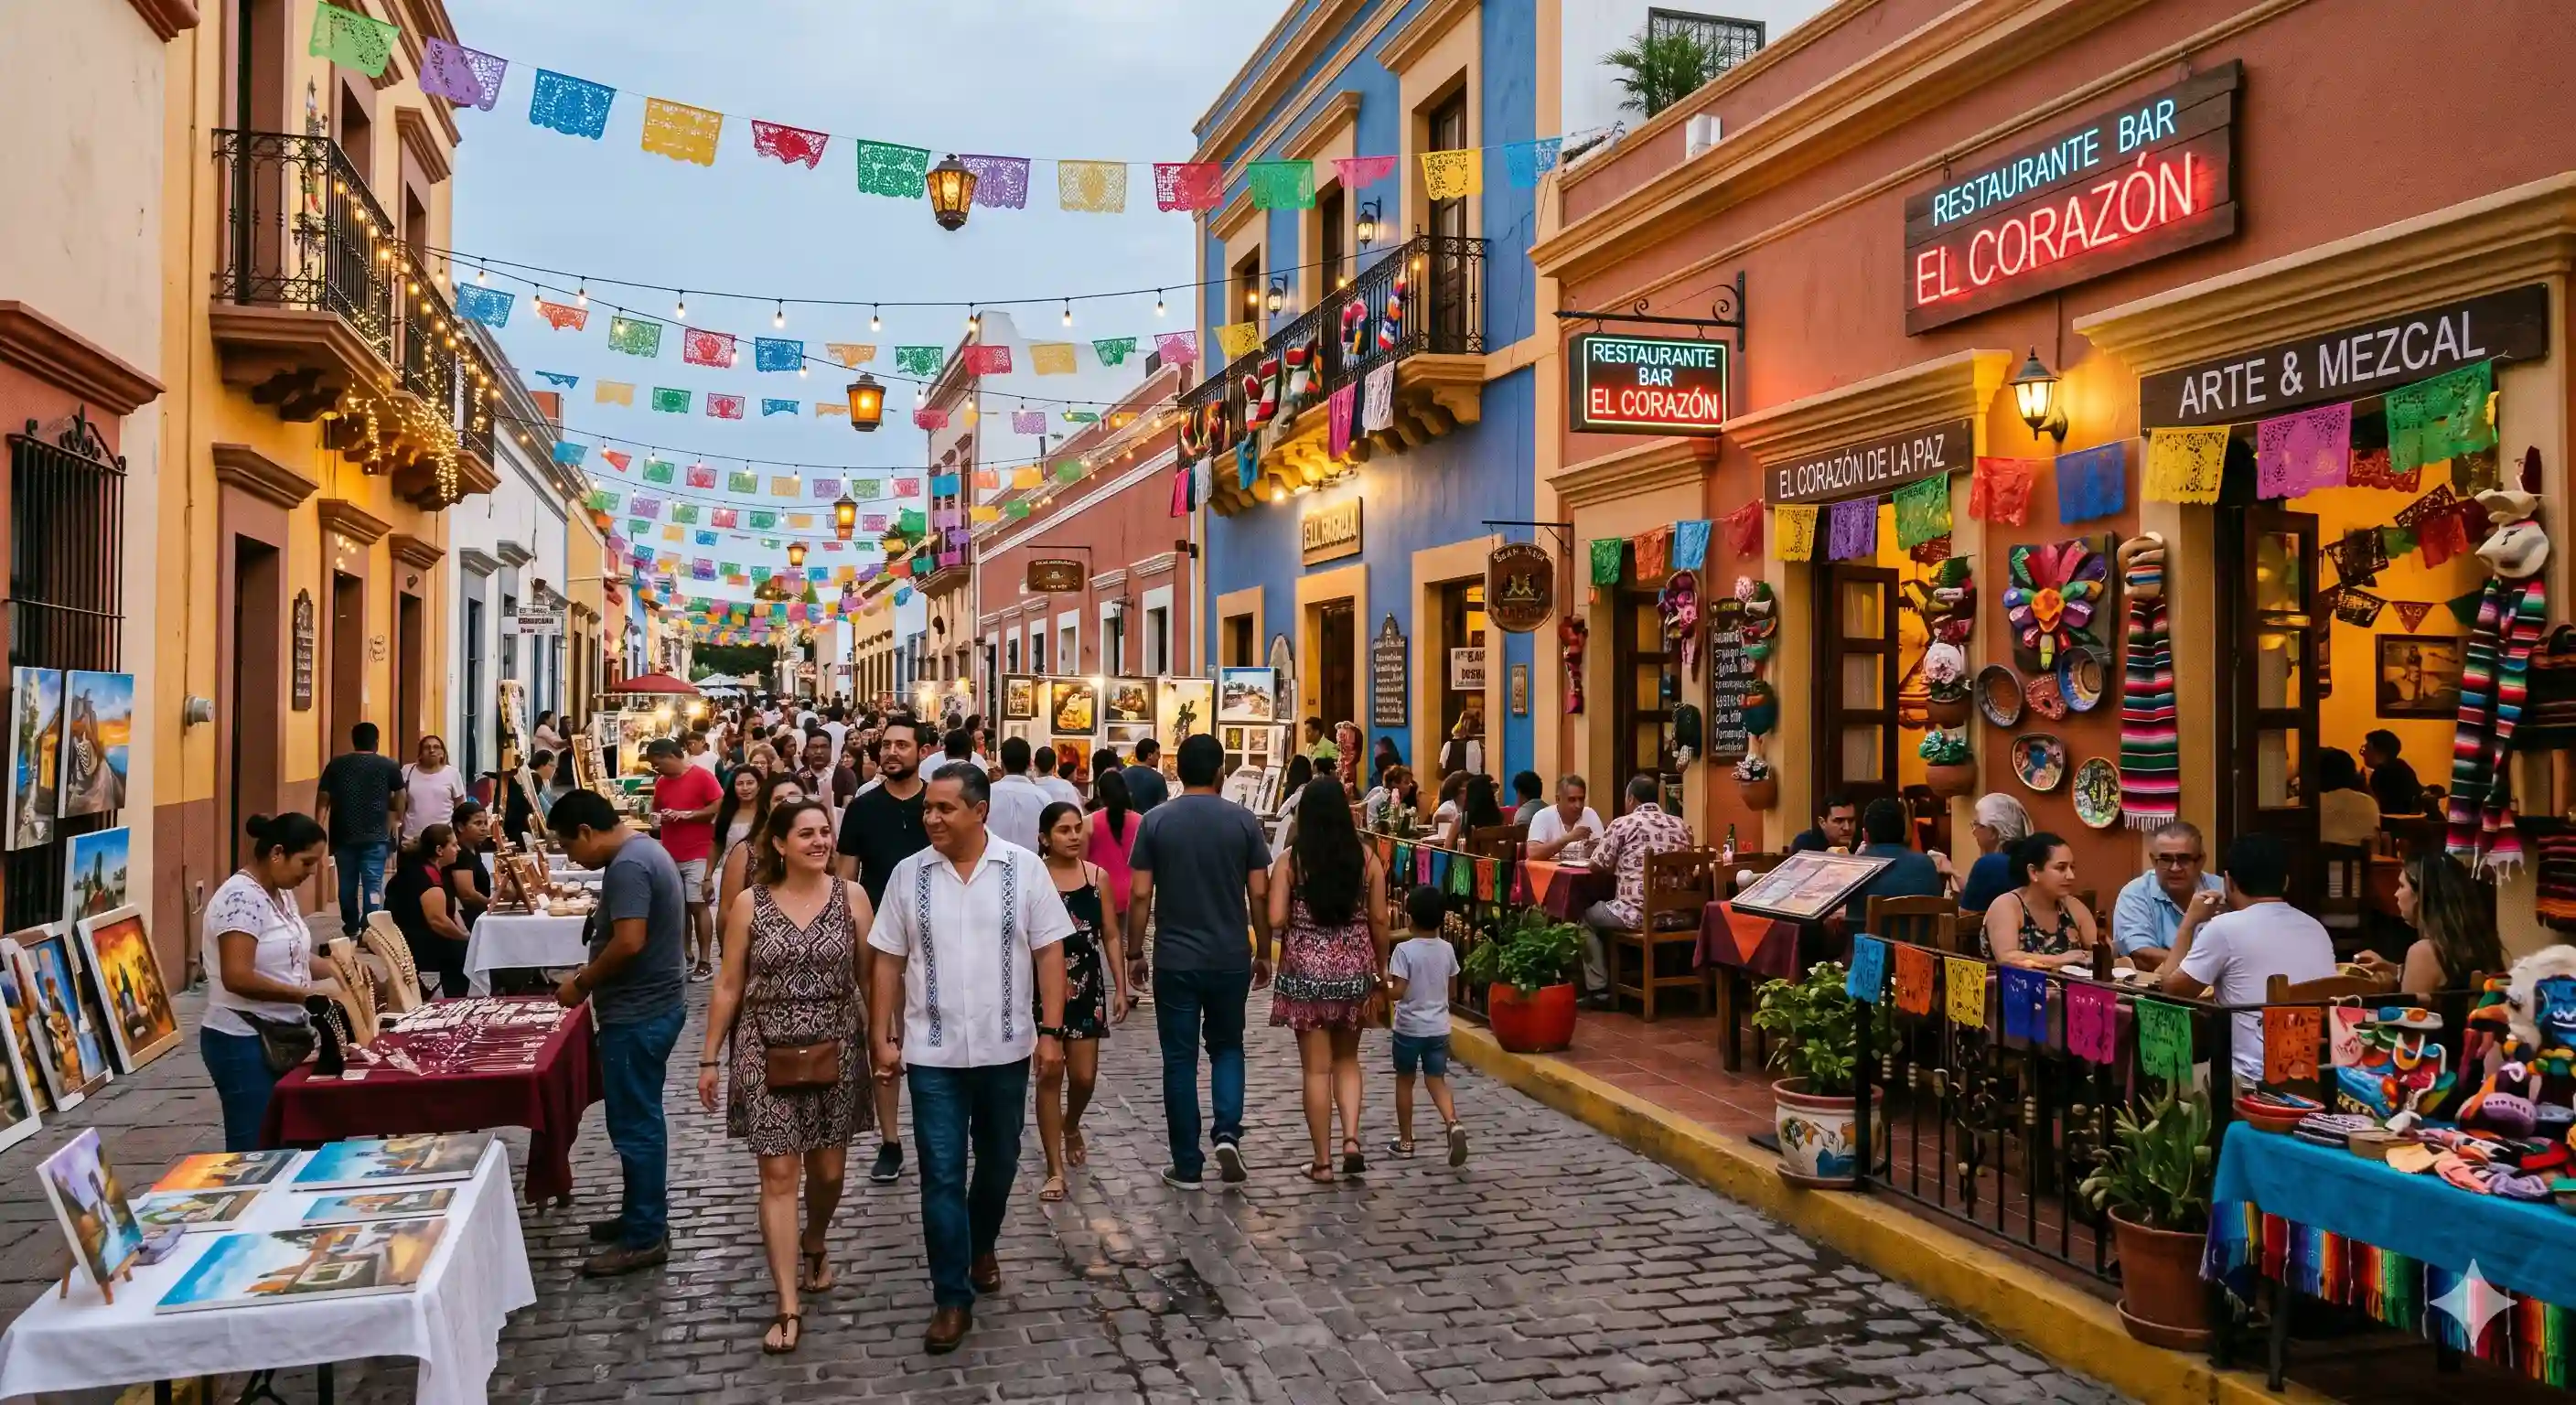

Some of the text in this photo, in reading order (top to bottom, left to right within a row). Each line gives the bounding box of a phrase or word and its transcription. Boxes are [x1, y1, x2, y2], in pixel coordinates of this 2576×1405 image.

[1933, 99, 2175, 227] RESTAURANTE BAR
[1916, 151, 2192, 305] EL CORAZÓN
[1593, 343, 1716, 368] RESTAURANTE
[1638, 367, 1673, 387] BAR
[2178, 311, 2485, 419] ARTE & MEZCAL
[1591, 387, 1718, 420] EL CORAZÓN
[1779, 434, 1946, 499] EL CORAZÓN DE LA PAZ
